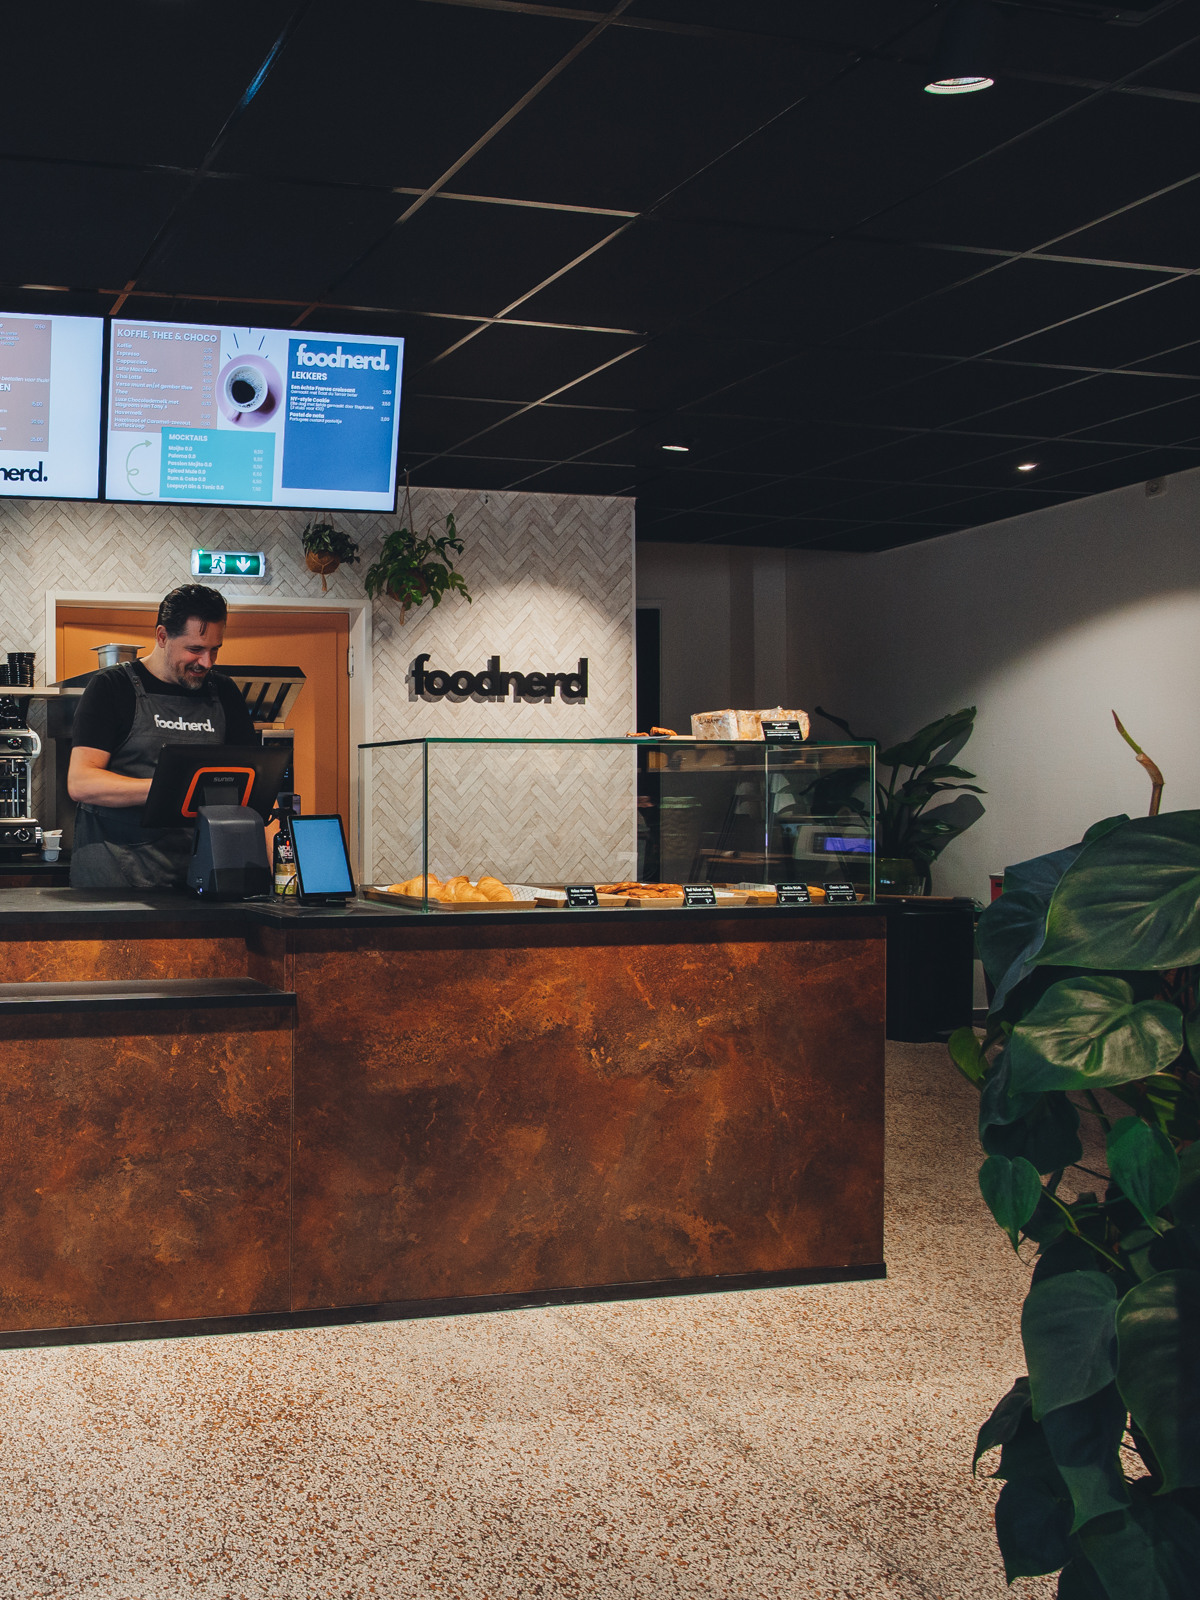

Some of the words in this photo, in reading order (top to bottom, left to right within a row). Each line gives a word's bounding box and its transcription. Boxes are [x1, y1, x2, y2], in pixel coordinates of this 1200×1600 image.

[118, 329, 150, 339] KOFFIE,
[152, 331, 173, 340] THEE
[184, 333, 217, 342] CHOCO
[297, 343, 390, 371] foodnerd.
[292, 371, 327, 380] LEKKERS
[412, 653, 587, 698] foodnerd
[154, 714, 214, 732] foodnerd.
